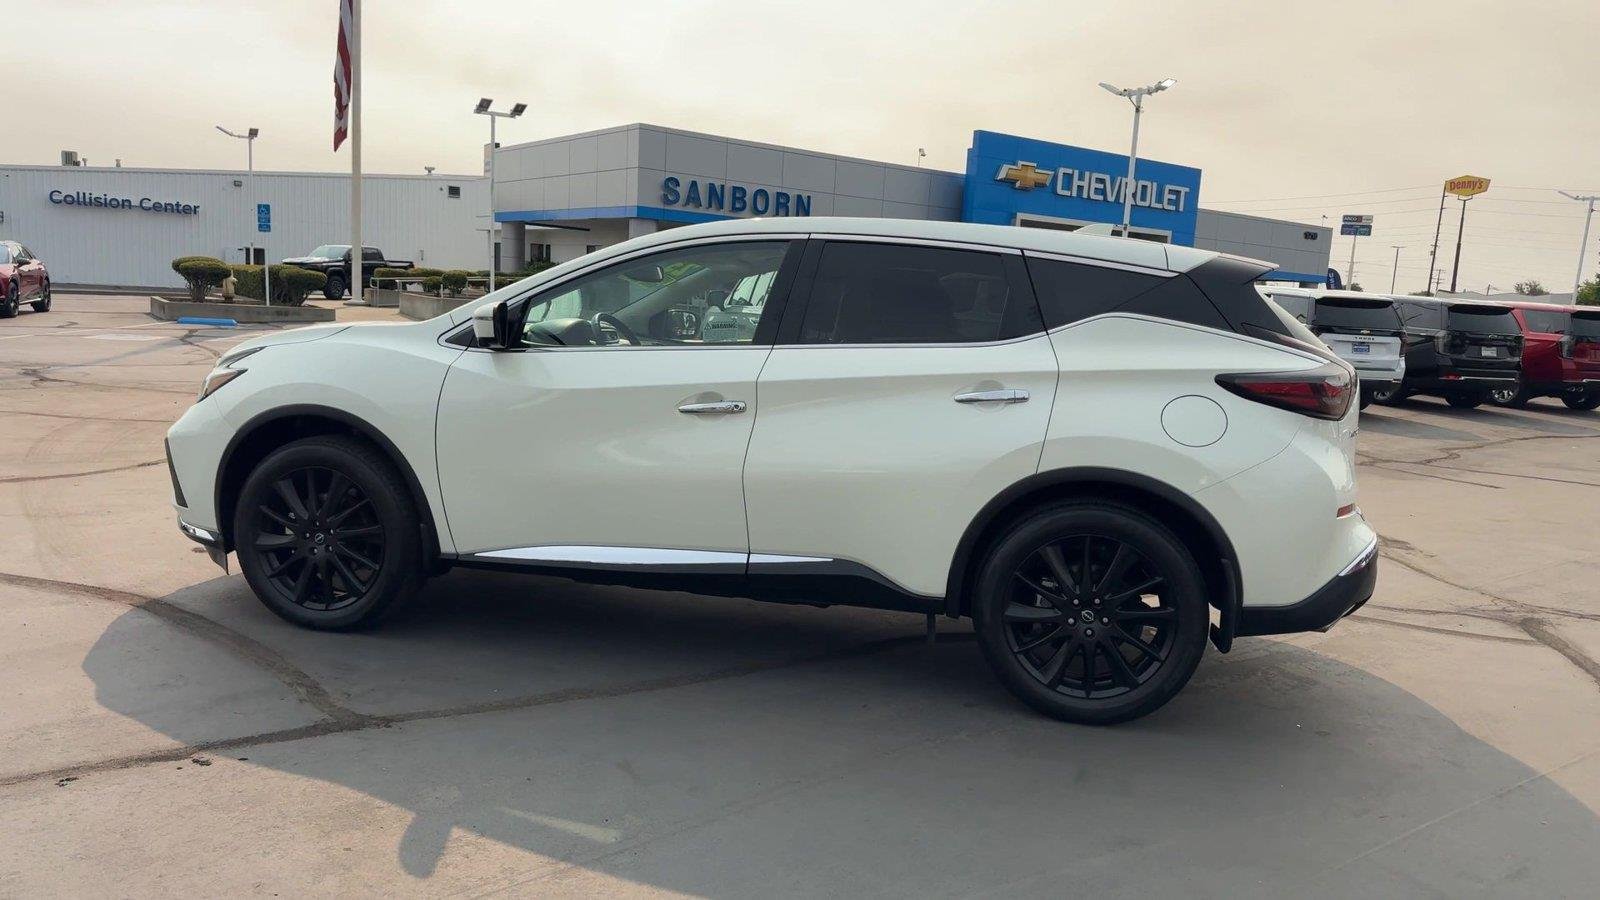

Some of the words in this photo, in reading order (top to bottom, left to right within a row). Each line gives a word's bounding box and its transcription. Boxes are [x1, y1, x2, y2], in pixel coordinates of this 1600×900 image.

[663, 176, 811, 217] SANBORN
[1056, 167, 1190, 212] CHEVROLET
[1449, 179, 1484, 191] Denny's
[49, 189, 132, 209] Collision
[139, 197, 200, 215] Center
